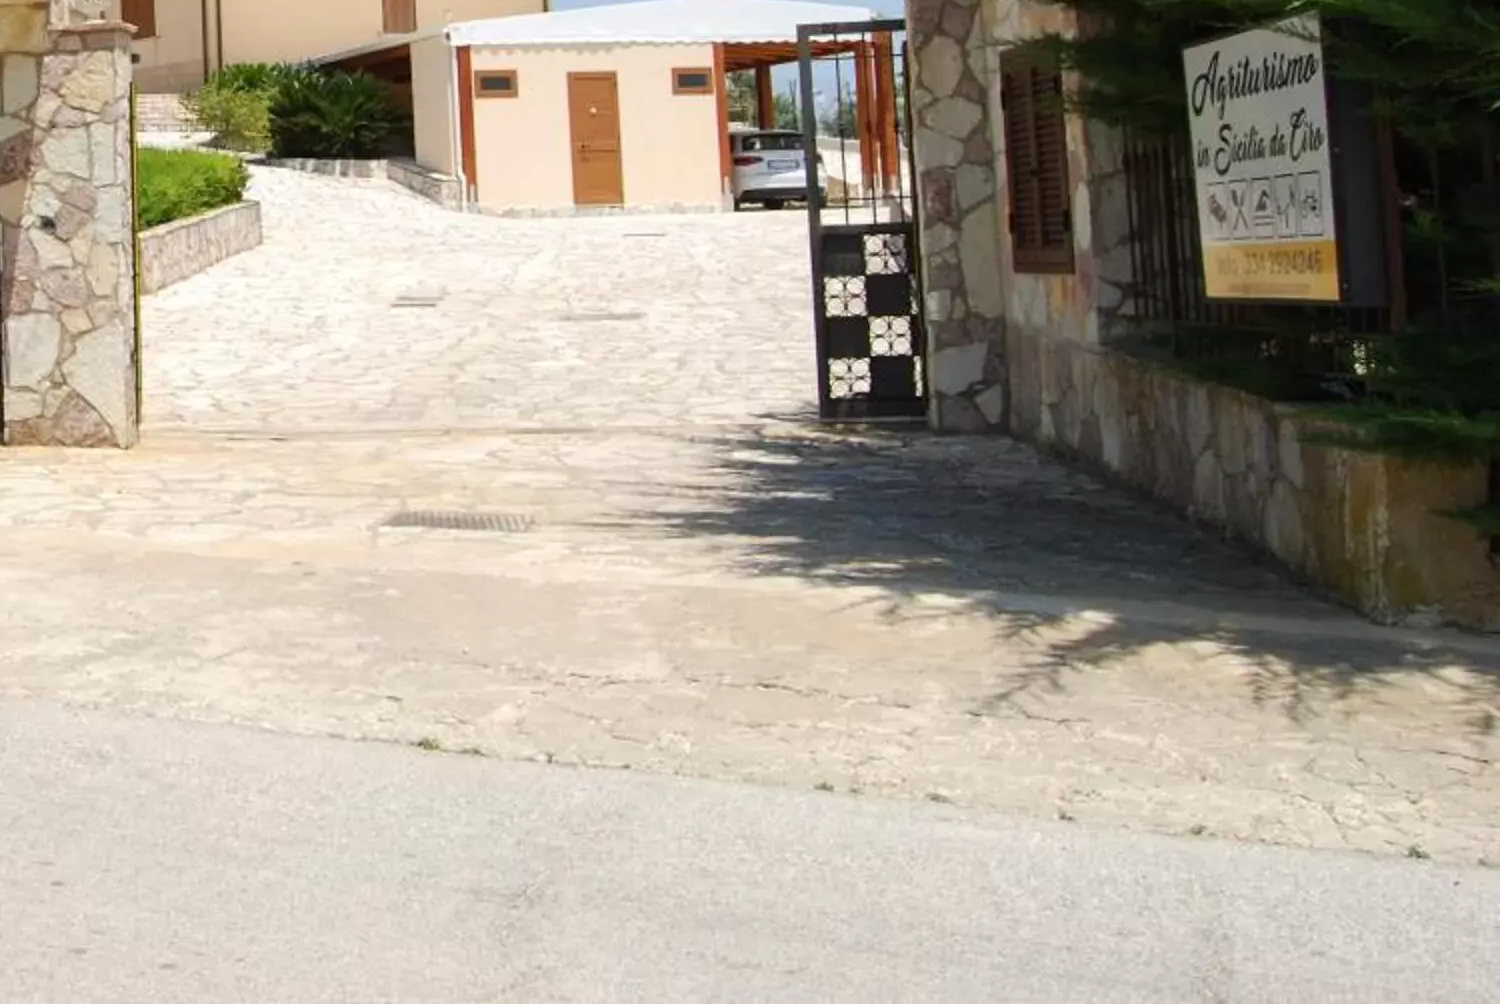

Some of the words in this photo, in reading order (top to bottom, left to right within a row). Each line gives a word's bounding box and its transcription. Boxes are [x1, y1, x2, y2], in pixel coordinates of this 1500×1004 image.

[1191, 51, 1318, 120] Agriturismo
[1196, 139, 1210, 167] in
[1214, 123, 1266, 175] Sicilia
[1269, 123, 1285, 157] da
[1289, 106, 1324, 161] Ciro
